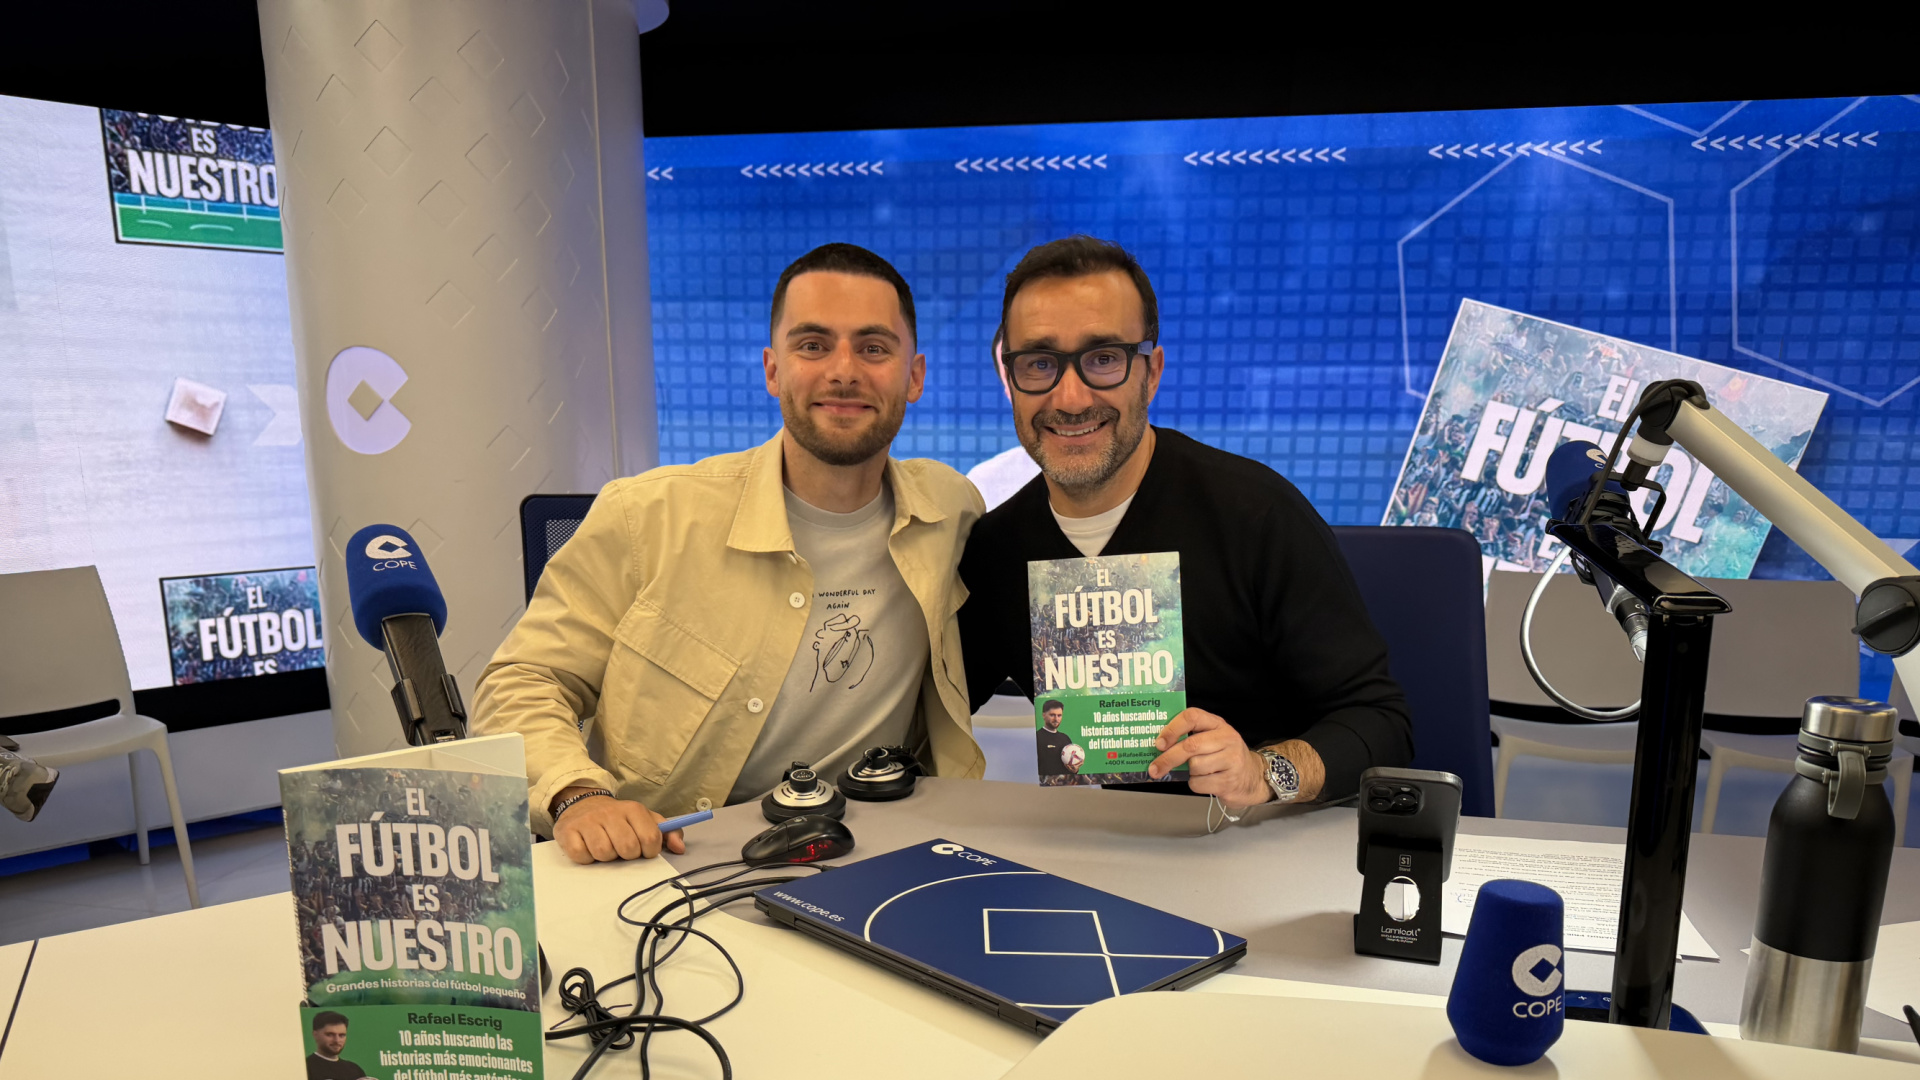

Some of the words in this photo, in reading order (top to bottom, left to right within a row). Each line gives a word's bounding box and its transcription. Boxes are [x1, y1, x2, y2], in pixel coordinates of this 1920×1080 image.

[190, 127, 217, 154] ES
[127, 149, 279, 207] NUESTRO
[1597, 375, 1640, 423] EL
[373, 560, 417, 571] COPE
[1096, 568, 1112, 587] EL
[246, 585, 267, 609] EL
[818, 589, 859, 598] WONDERFUL
[1055, 585, 1159, 629] FÚTBOL
[199, 607, 324, 661] FÚTBOL
[1097, 629, 1116, 649] ES
[1044, 650, 1174, 691] NUESTRO
[1099, 699, 1129, 708] Rafael
[1131, 698, 1161, 707] Escrig
[1093, 712, 1101, 723] 10
[1102, 711, 1120, 723] años
[1120, 710, 1155, 722] buscando
[1156, 709, 1168, 720] las
[1081, 725, 1113, 737] historias
[1113, 724, 1129, 735] más
[1088, 738, 1100, 749] del
[1100, 737, 1123, 749] fútbol
[1123, 736, 1139, 748] más
[405, 787, 430, 816] EL
[335, 811, 499, 883] FÚTBOL
[958, 851, 997, 866] COPE
[1400, 857, 1410, 865] S1
[411, 883, 440, 912] ES
[773, 891, 845, 922] www.cope.es
[321, 919, 523, 980] NUESTRO
[326, 979, 379, 993] Grandes
[380, 978, 431, 989] historias
[432, 979, 449, 989] del
[450, 979, 482, 993] fútbol
[482, 985, 526, 1000] pequeño
[1512, 995, 1562, 1018] COPE
[407, 1012, 455, 1025] Rafael
[457, 1013, 503, 1031] Escrig
[399, 1030, 412, 1047] 10
[413, 1030, 442, 1047] años
[442, 1030, 496, 1050] buscando
[496, 1034, 513, 1051] las
[379, 1050, 432, 1067] historias
[433, 1050, 457, 1066] más
[458, 1052, 533, 1074] emocionantes
